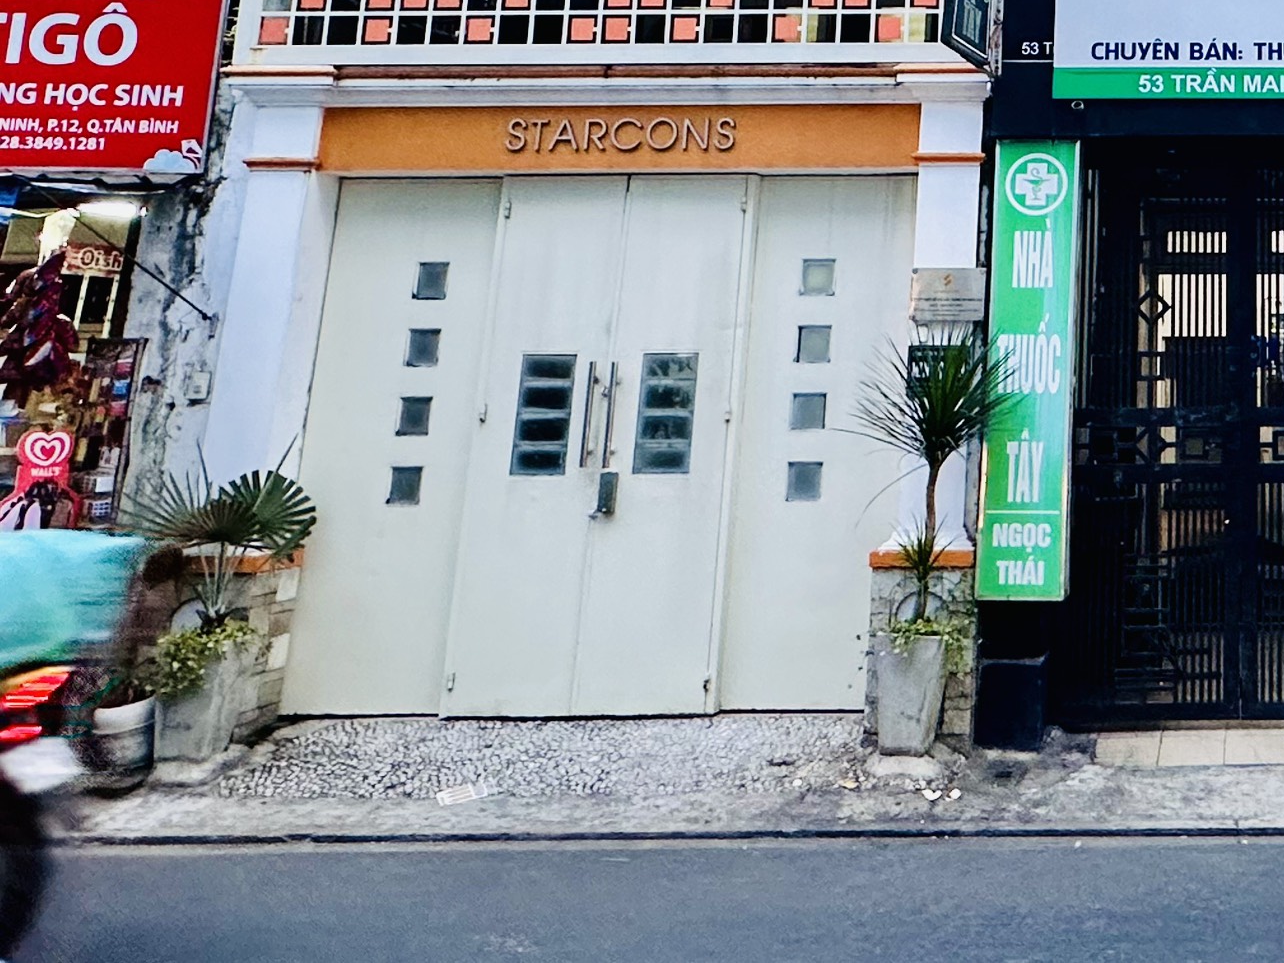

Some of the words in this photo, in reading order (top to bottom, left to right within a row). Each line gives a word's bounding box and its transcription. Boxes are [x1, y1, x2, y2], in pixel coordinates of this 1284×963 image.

[0, 2, 138, 67] IGÔ
[1022, 42, 1039, 55] 53
[1090, 39, 1180, 61] CHUYÊN
[1189, 38, 1243, 61] BÁN:
[1138, 74, 1164, 93] 53
[1170, 67, 1238, 93] TRẦN
[1243, 74, 1284, 93] MAI
[43, 83, 109, 111] HỌC
[113, 84, 184, 107] SINH
[138, 118, 179, 134] BÌNH
[505, 117, 737, 152] STARCONS
[1012, 218, 1054, 288] NHÀ
[996, 312, 1061, 395] THUỐC
[1006, 427, 1044, 503] TÂY
[992, 523, 1051, 553] NGỌC
[996, 555, 1045, 585] THÁI
